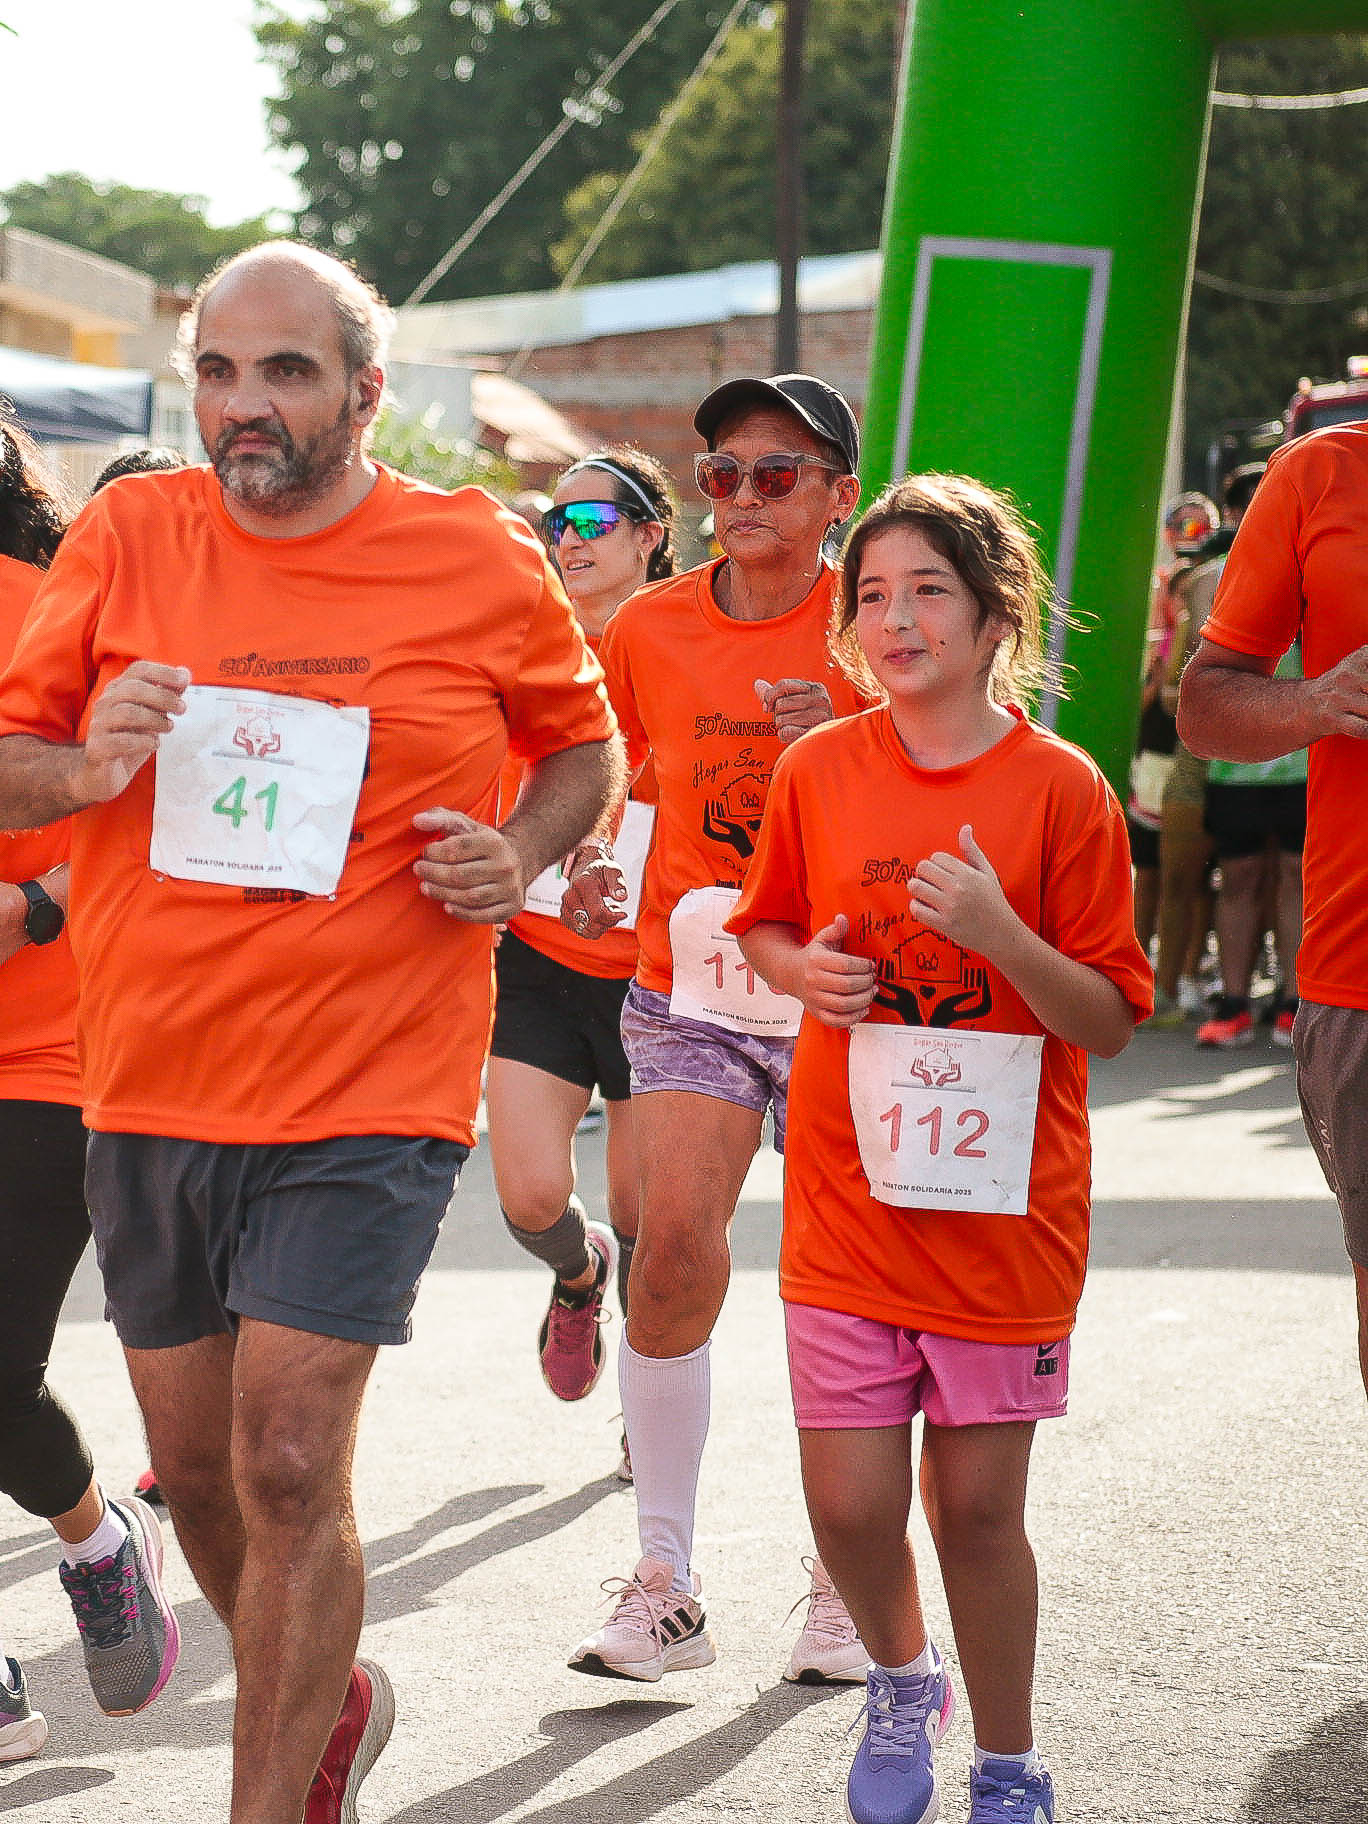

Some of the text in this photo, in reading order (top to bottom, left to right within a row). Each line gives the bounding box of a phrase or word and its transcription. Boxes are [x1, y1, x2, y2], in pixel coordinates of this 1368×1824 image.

[719, 718, 779, 736] ANIVERS
[212, 775, 279, 832] 41
[704, 951, 787, 996] 11
[880, 1103, 990, 1158] 112
[910, 1184, 952, 1195] SOLIDARIA
